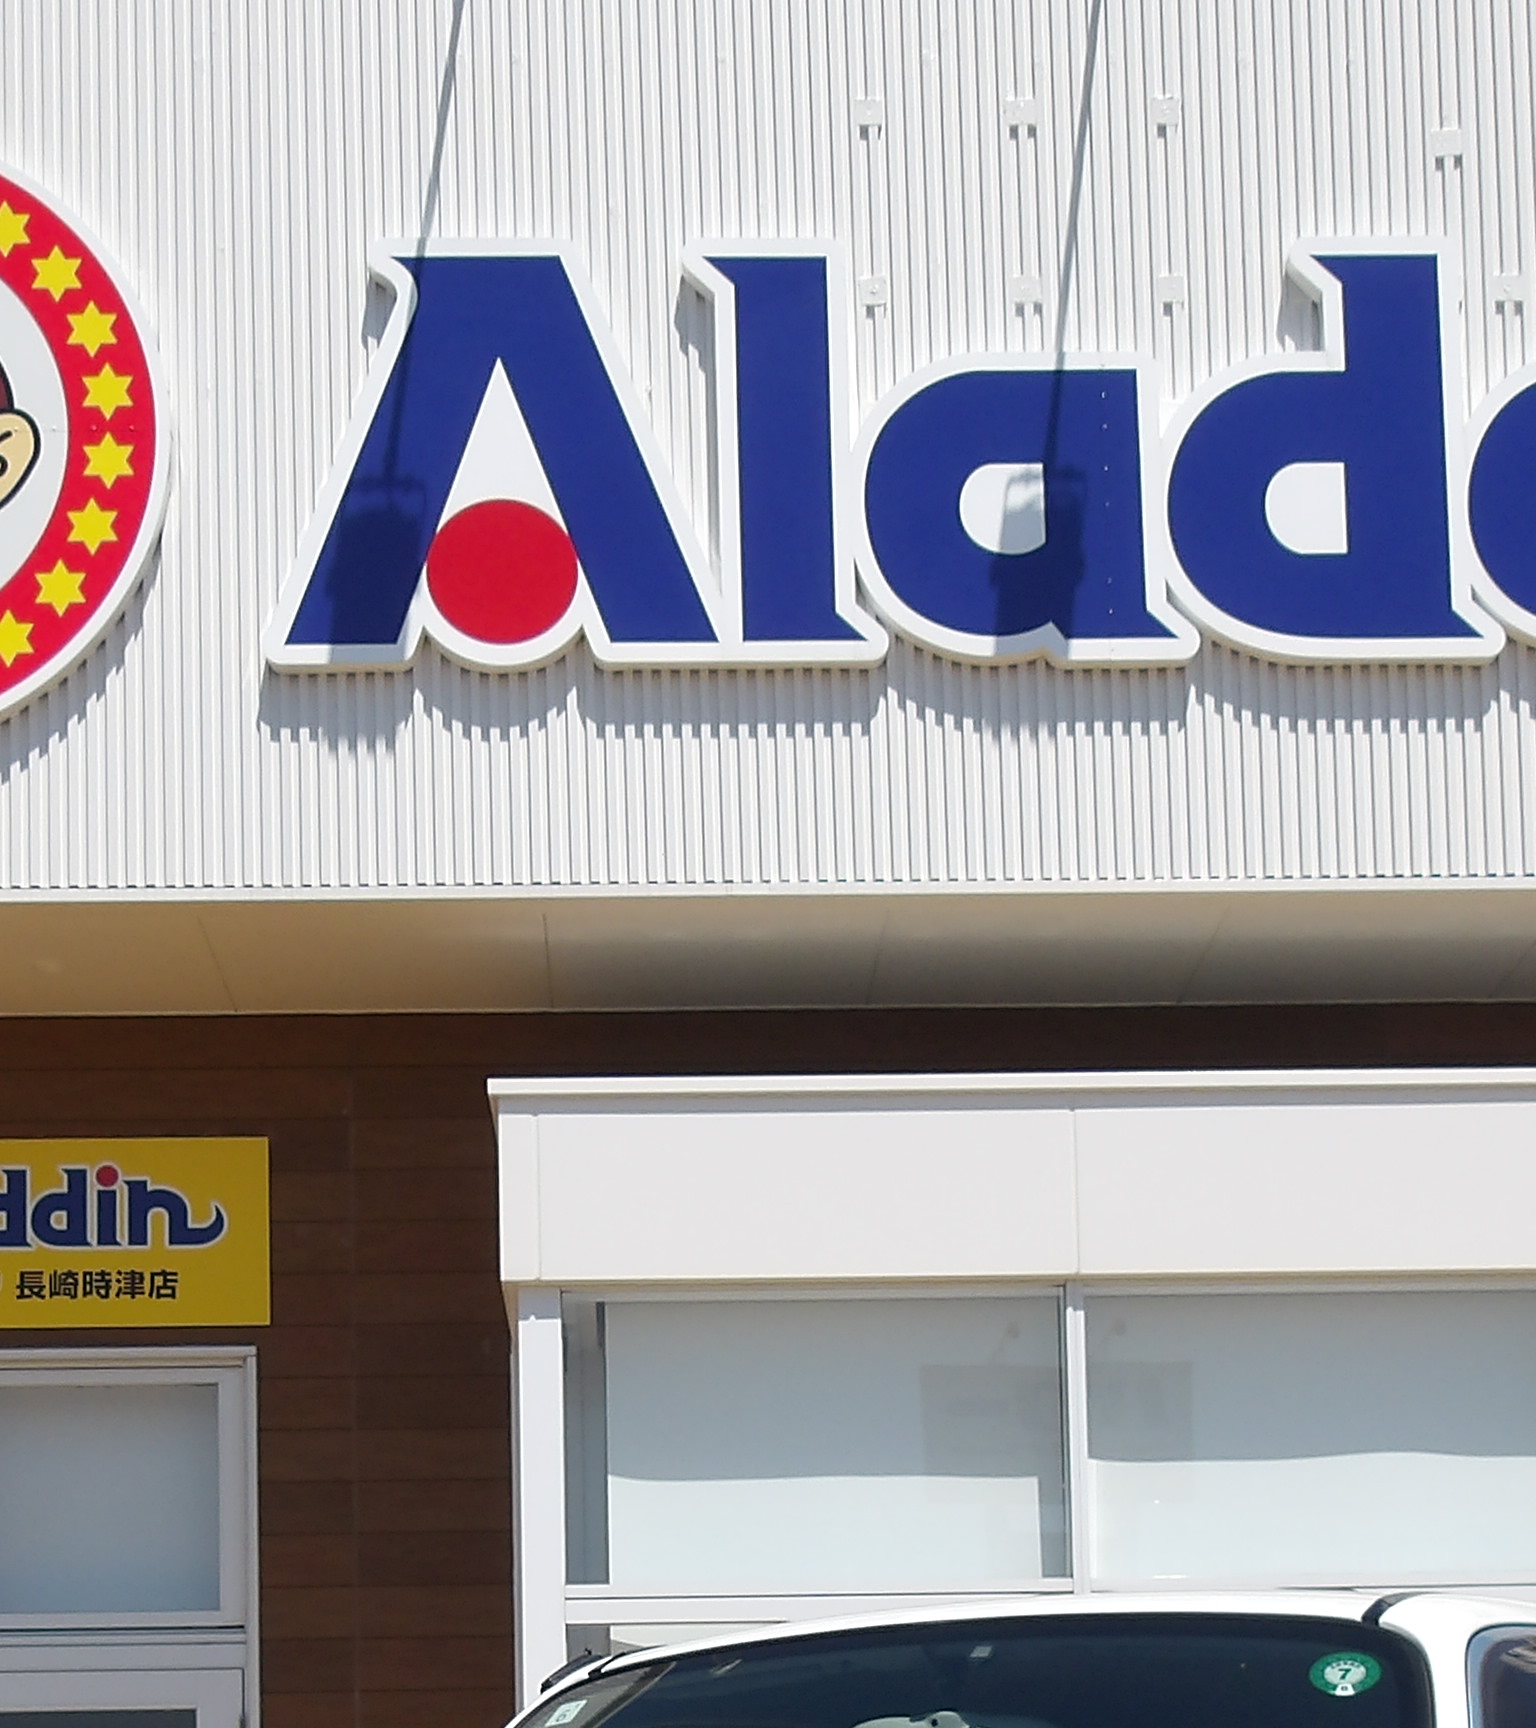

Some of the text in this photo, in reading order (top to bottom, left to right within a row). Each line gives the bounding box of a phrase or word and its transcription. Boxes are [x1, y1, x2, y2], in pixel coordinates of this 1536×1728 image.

[15, 1269, 180, 1301] 長崎時津店
